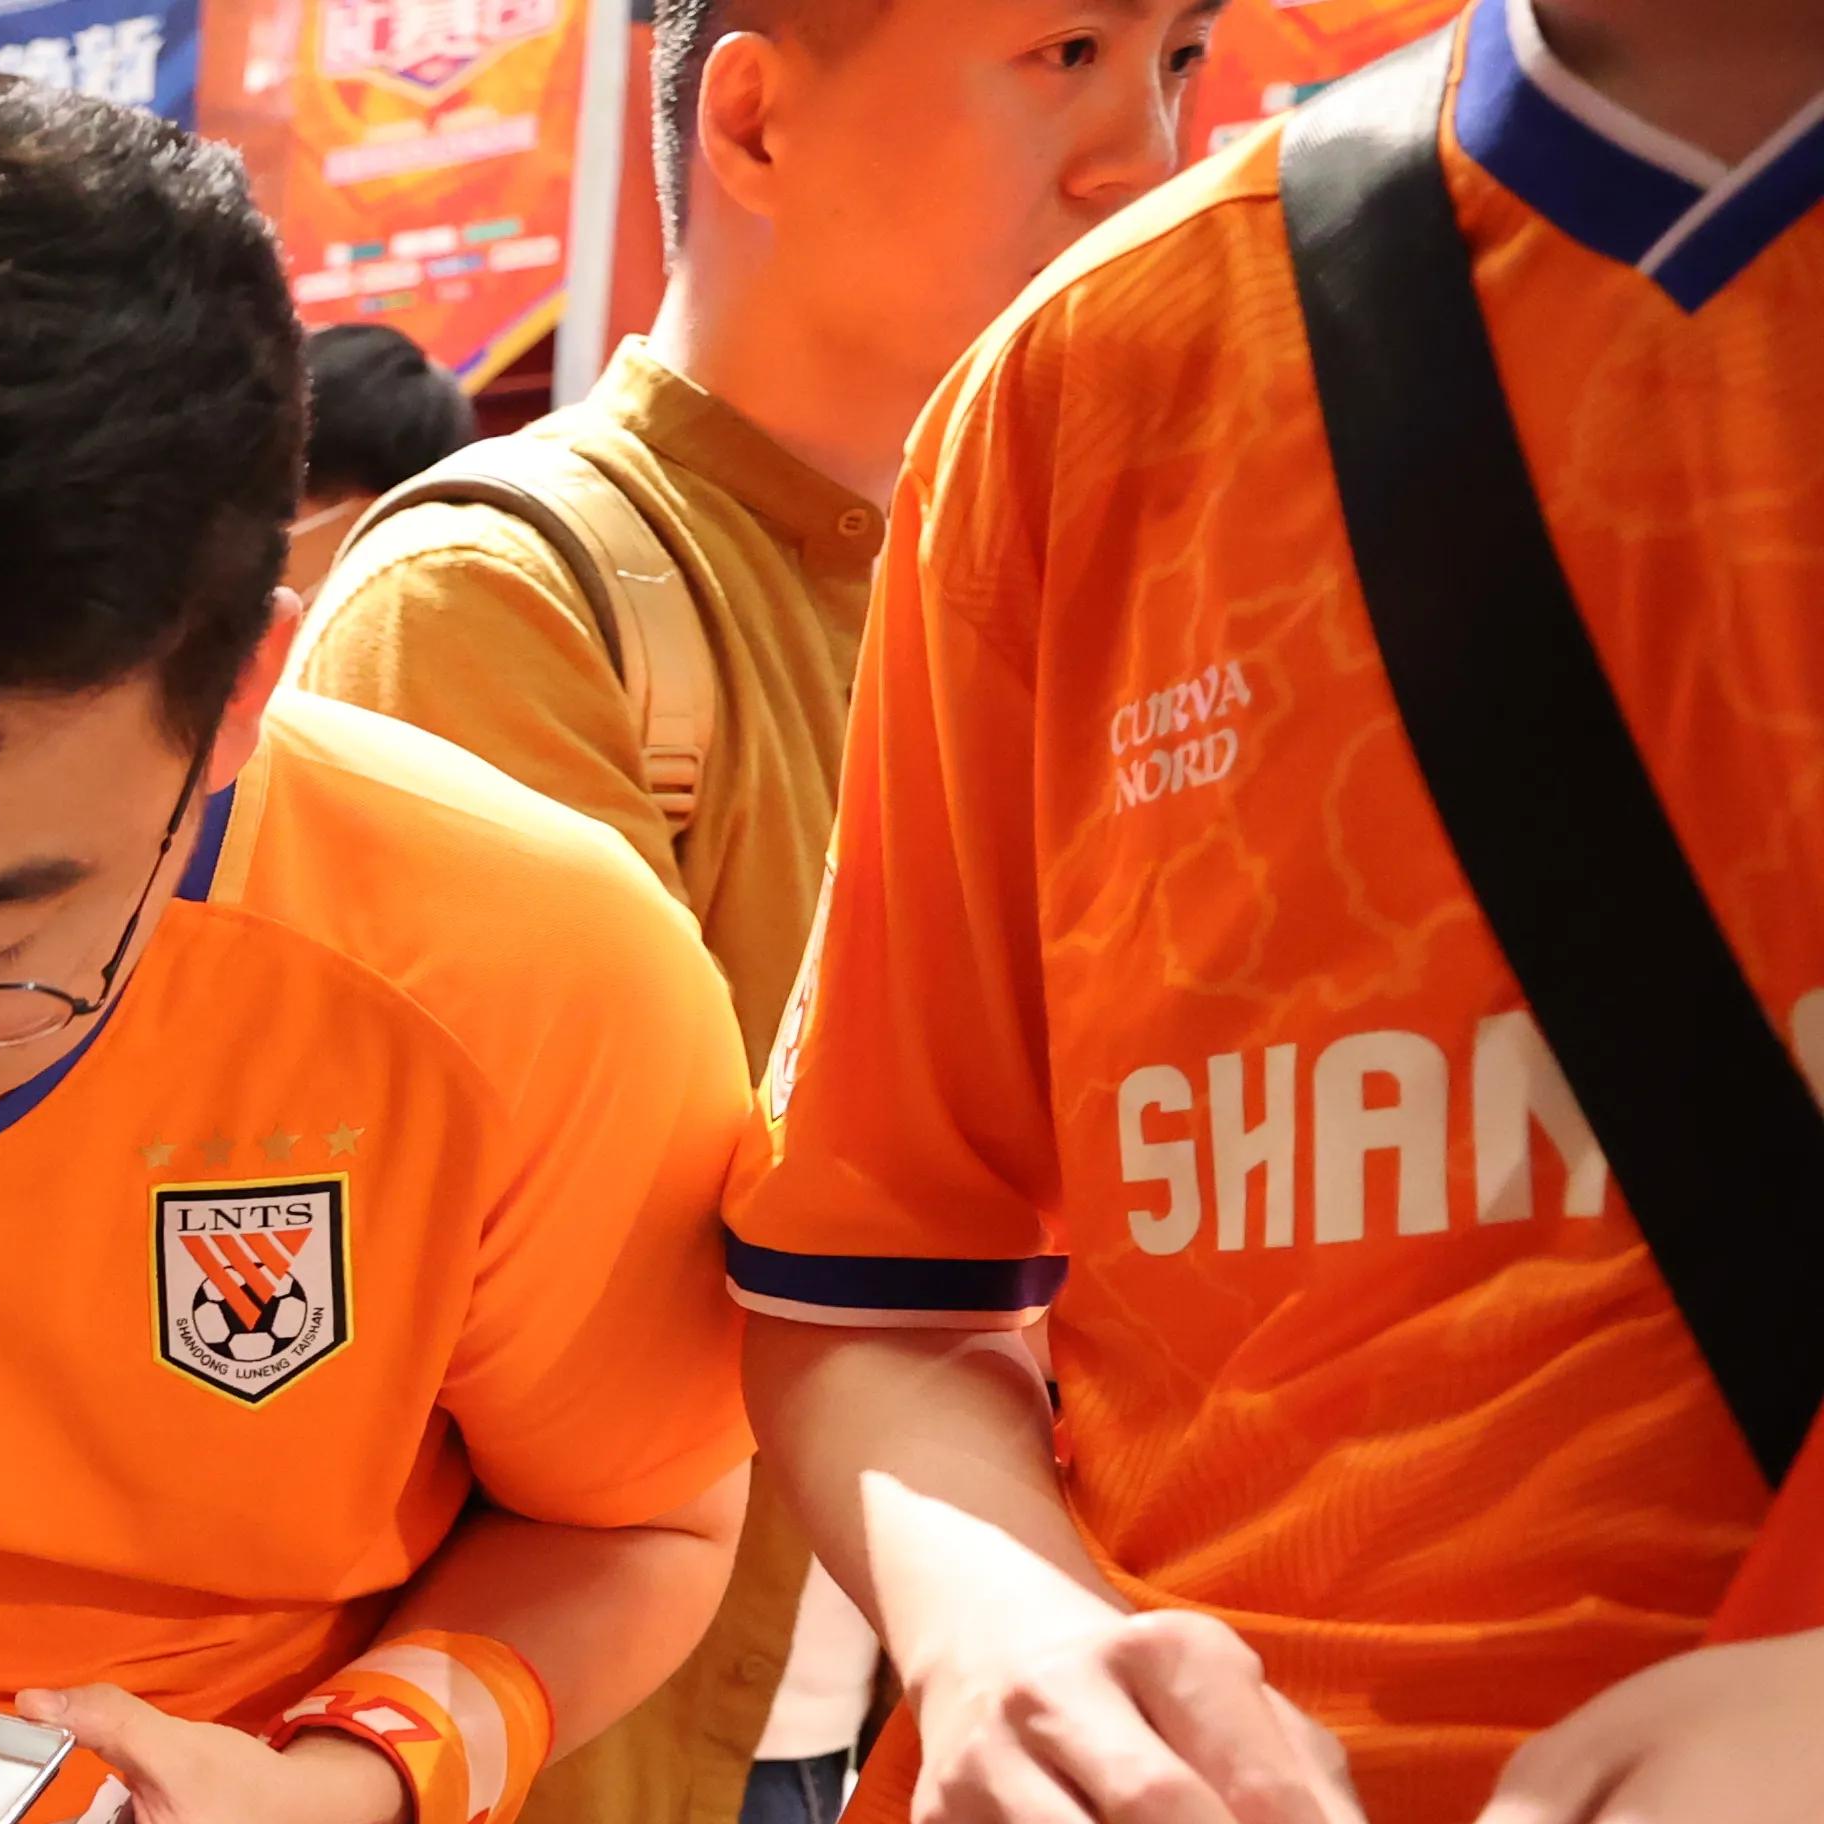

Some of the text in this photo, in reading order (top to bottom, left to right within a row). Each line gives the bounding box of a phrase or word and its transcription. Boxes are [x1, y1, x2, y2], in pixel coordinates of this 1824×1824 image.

[1111, 660, 1251, 756] CURVA
[1115, 728, 1238, 815] NORD
[177, 1202, 314, 1232] LNTS
[176, 1306, 325, 1380] SHANDONG LUNENG TAISHAN
